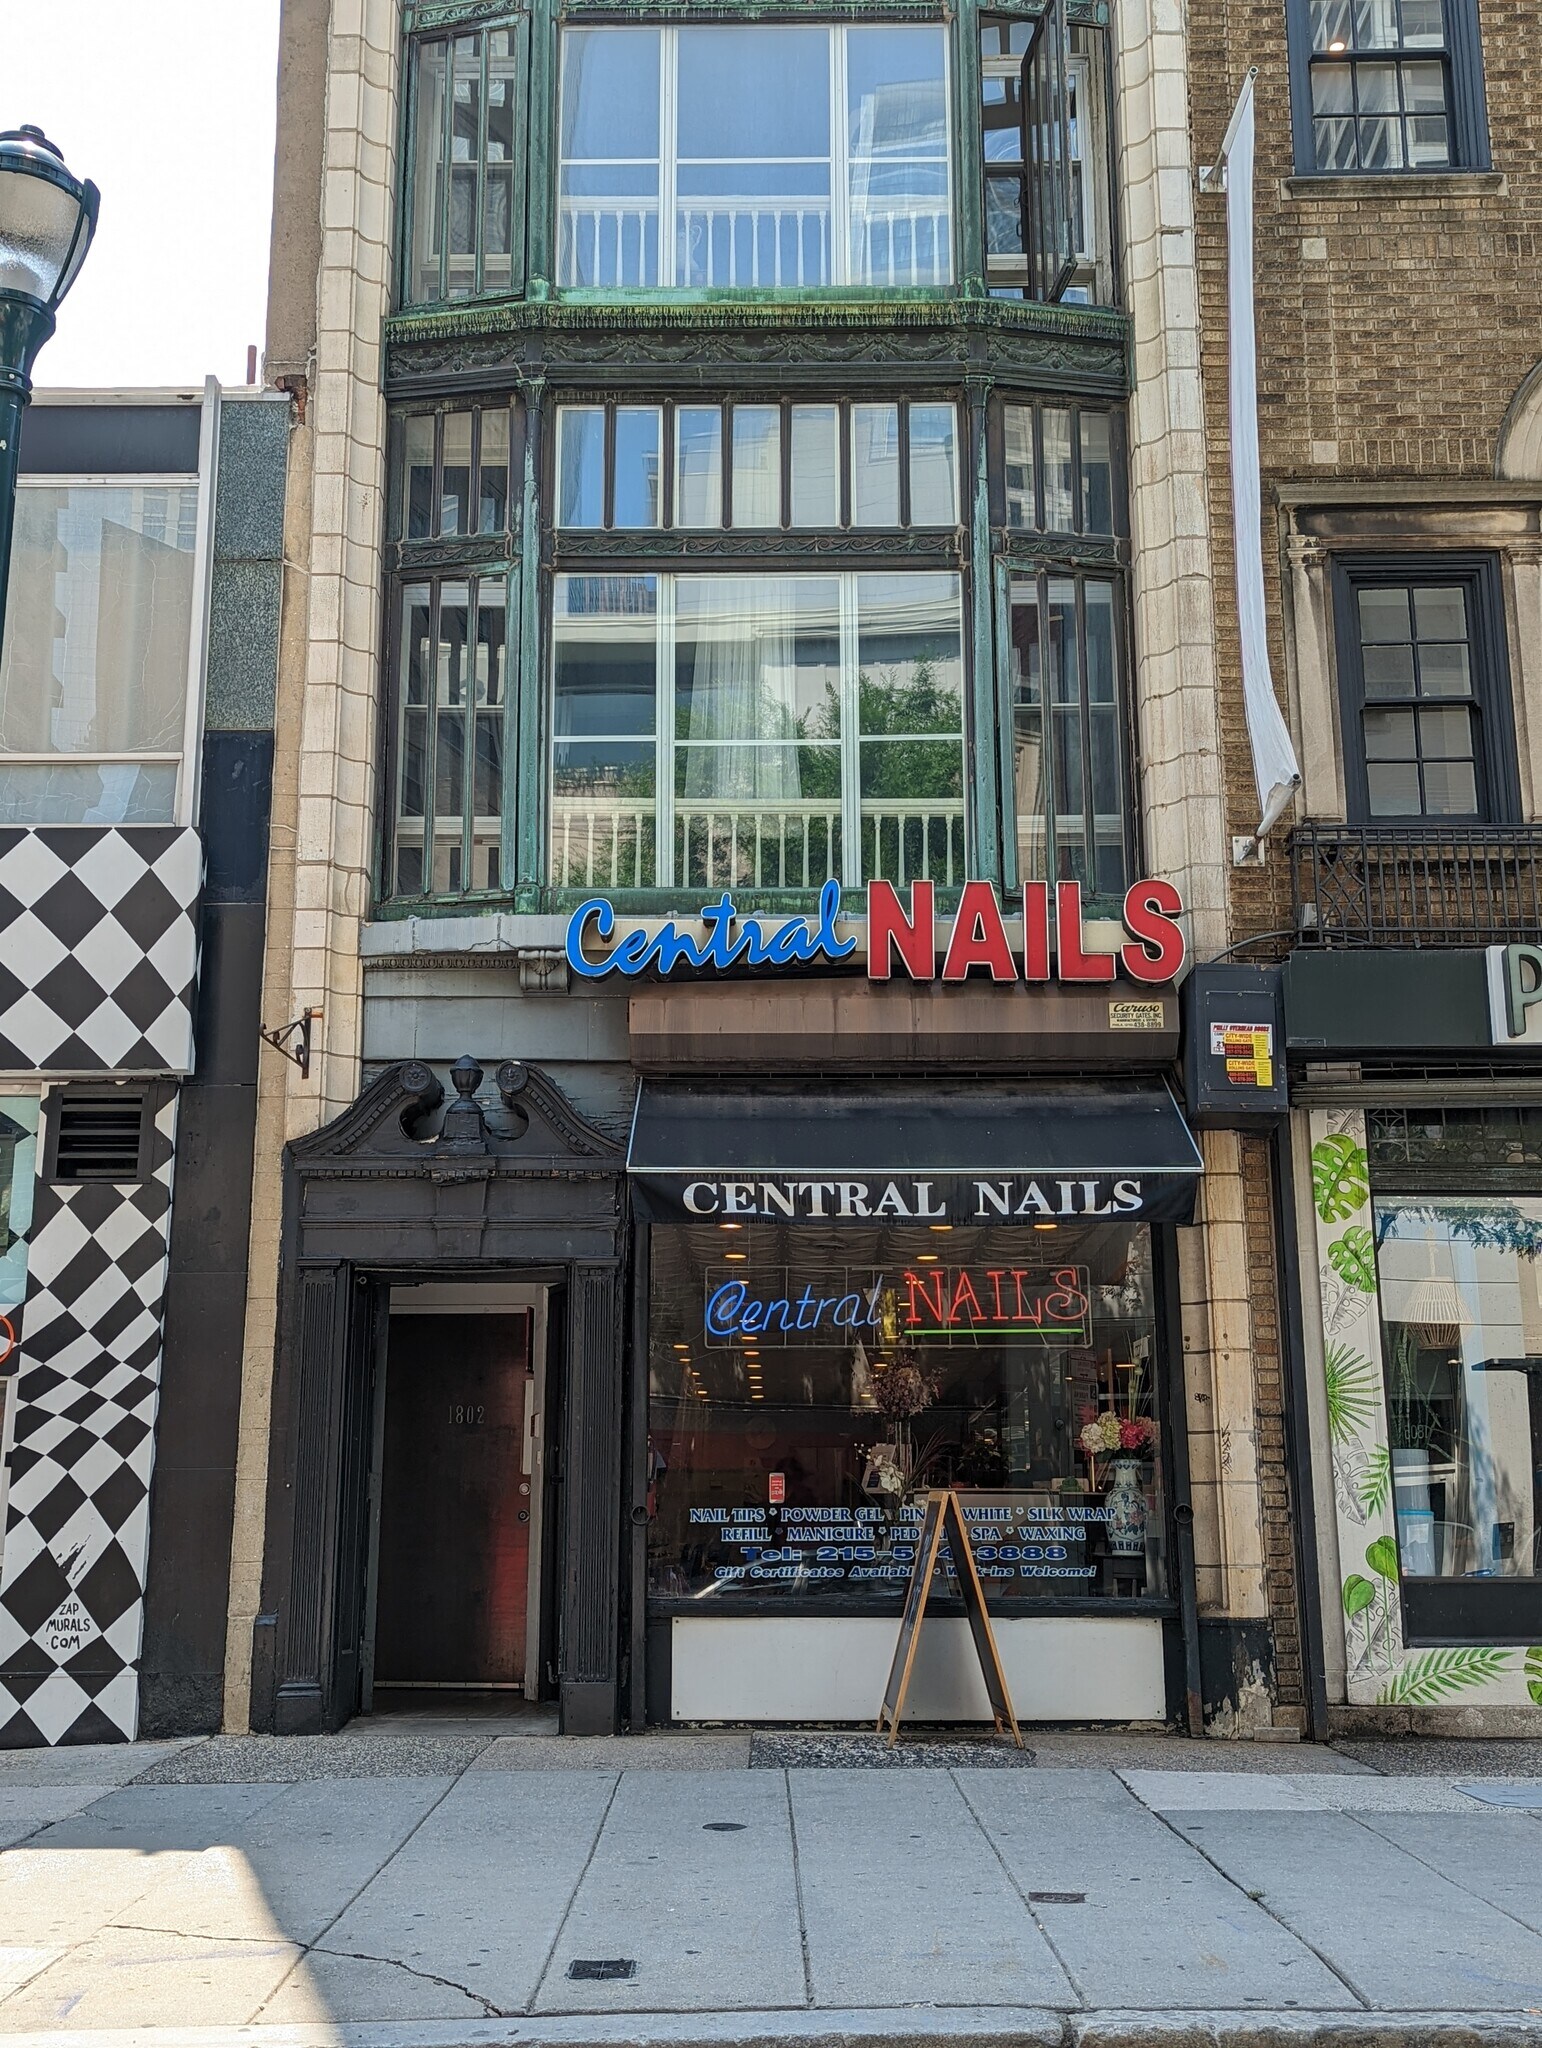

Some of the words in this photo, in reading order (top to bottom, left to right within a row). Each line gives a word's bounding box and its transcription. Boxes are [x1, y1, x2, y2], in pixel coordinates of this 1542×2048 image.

[566, 878, 858, 978] Central
[866, 879, 1186, 983] NAILS
[1113, 1003, 1160, 1012] Caruso
[683, 1181, 947, 1217] CENTRAL
[972, 1180, 1144, 1215] NAILS
[705, 1273, 883, 1336] Central
[903, 1266, 1090, 1322] NAILS
[448, 1404, 485, 1424] 1802
[689, 1508, 730, 1523] NAIL
[731, 1508, 766, 1523] TIPS
[780, 1508, 851, 1522] POWDER
[854, 1508, 885, 1522] GEL
[961, 1507, 1013, 1521] WHITE
[1027, 1507, 1065, 1521] SILK
[1067, 1507, 1117, 1521] WRAP
[721, 1527, 772, 1541] REFILL
[786, 1527, 876, 1541] MANICURE
[971, 1527, 1003, 1541] SPA
[1018, 1527, 1087, 1541] WAXING
[740, 1547, 803, 1562] Tel:
[714, 1566, 745, 1579] Gift
[750, 1566, 845, 1579] Certificates
[848, 1566, 914, 1578] Availabl
[1020, 1566, 1098, 1578] Welcome!
[59, 1603, 79, 1615] ZAP
[45, 1618, 90, 1632] MURALS
